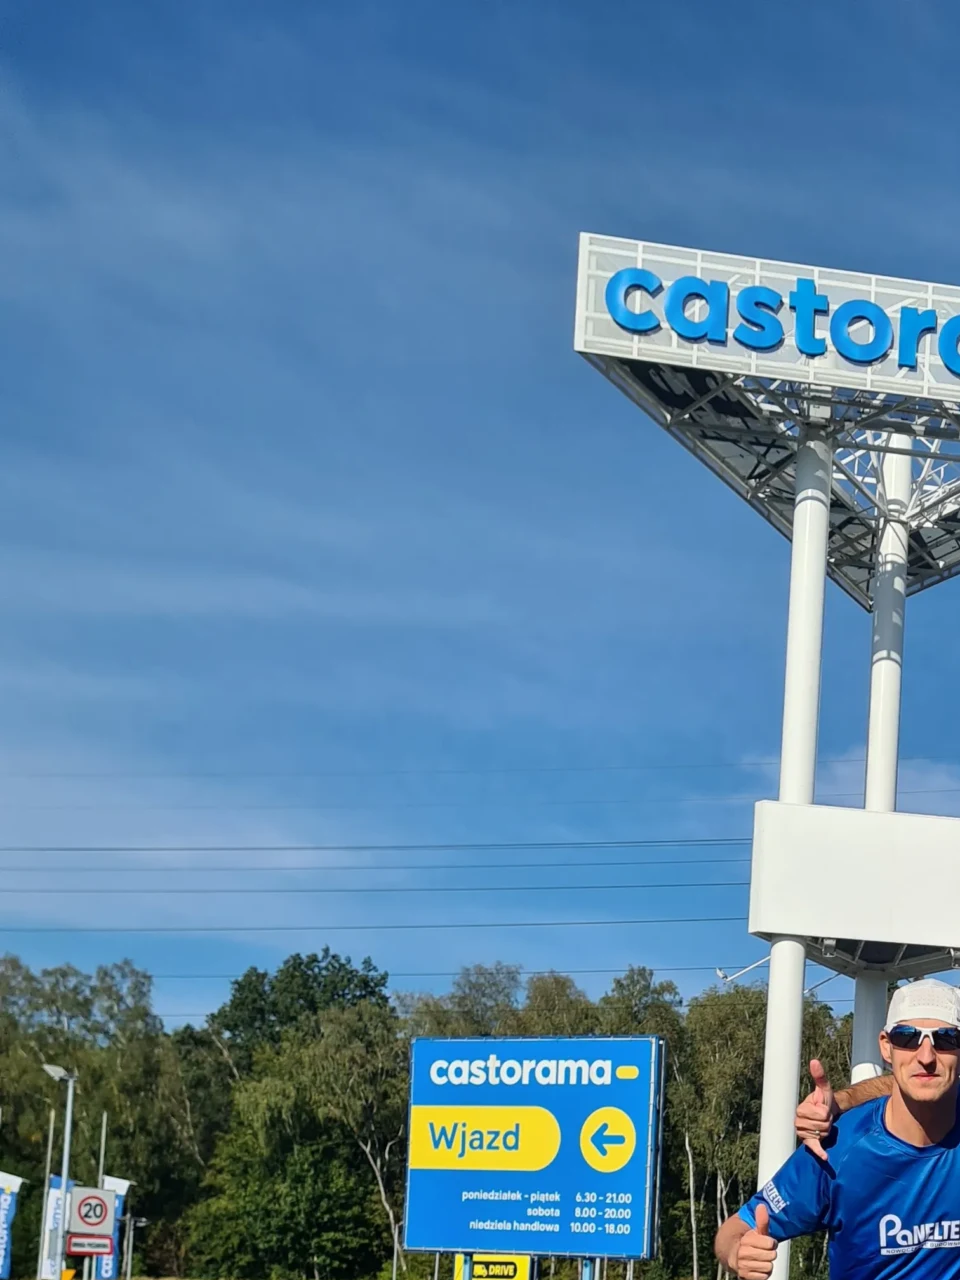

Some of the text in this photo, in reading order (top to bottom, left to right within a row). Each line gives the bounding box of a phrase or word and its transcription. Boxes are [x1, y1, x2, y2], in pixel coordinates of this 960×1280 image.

[429, 1054, 613, 1086] castorama
[428, 1122, 520, 1158] Wjazd
[575, 1192, 597, 1203] 6.30
[605, 1192, 633, 1204] 21.00
[83, 1202, 104, 1219] 20
[526, 1206, 560, 1217] sobota
[574, 1207, 597, 1218] 8.00
[604, 1208, 632, 1219] 20.00
[469, 1219, 512, 1231] niedziela
[513, 1220, 560, 1232] handlowa
[570, 1222, 596, 1233] 10.00
[604, 1223, 631, 1235] 18.00
[489, 1264, 515, 1276] DRIVE
